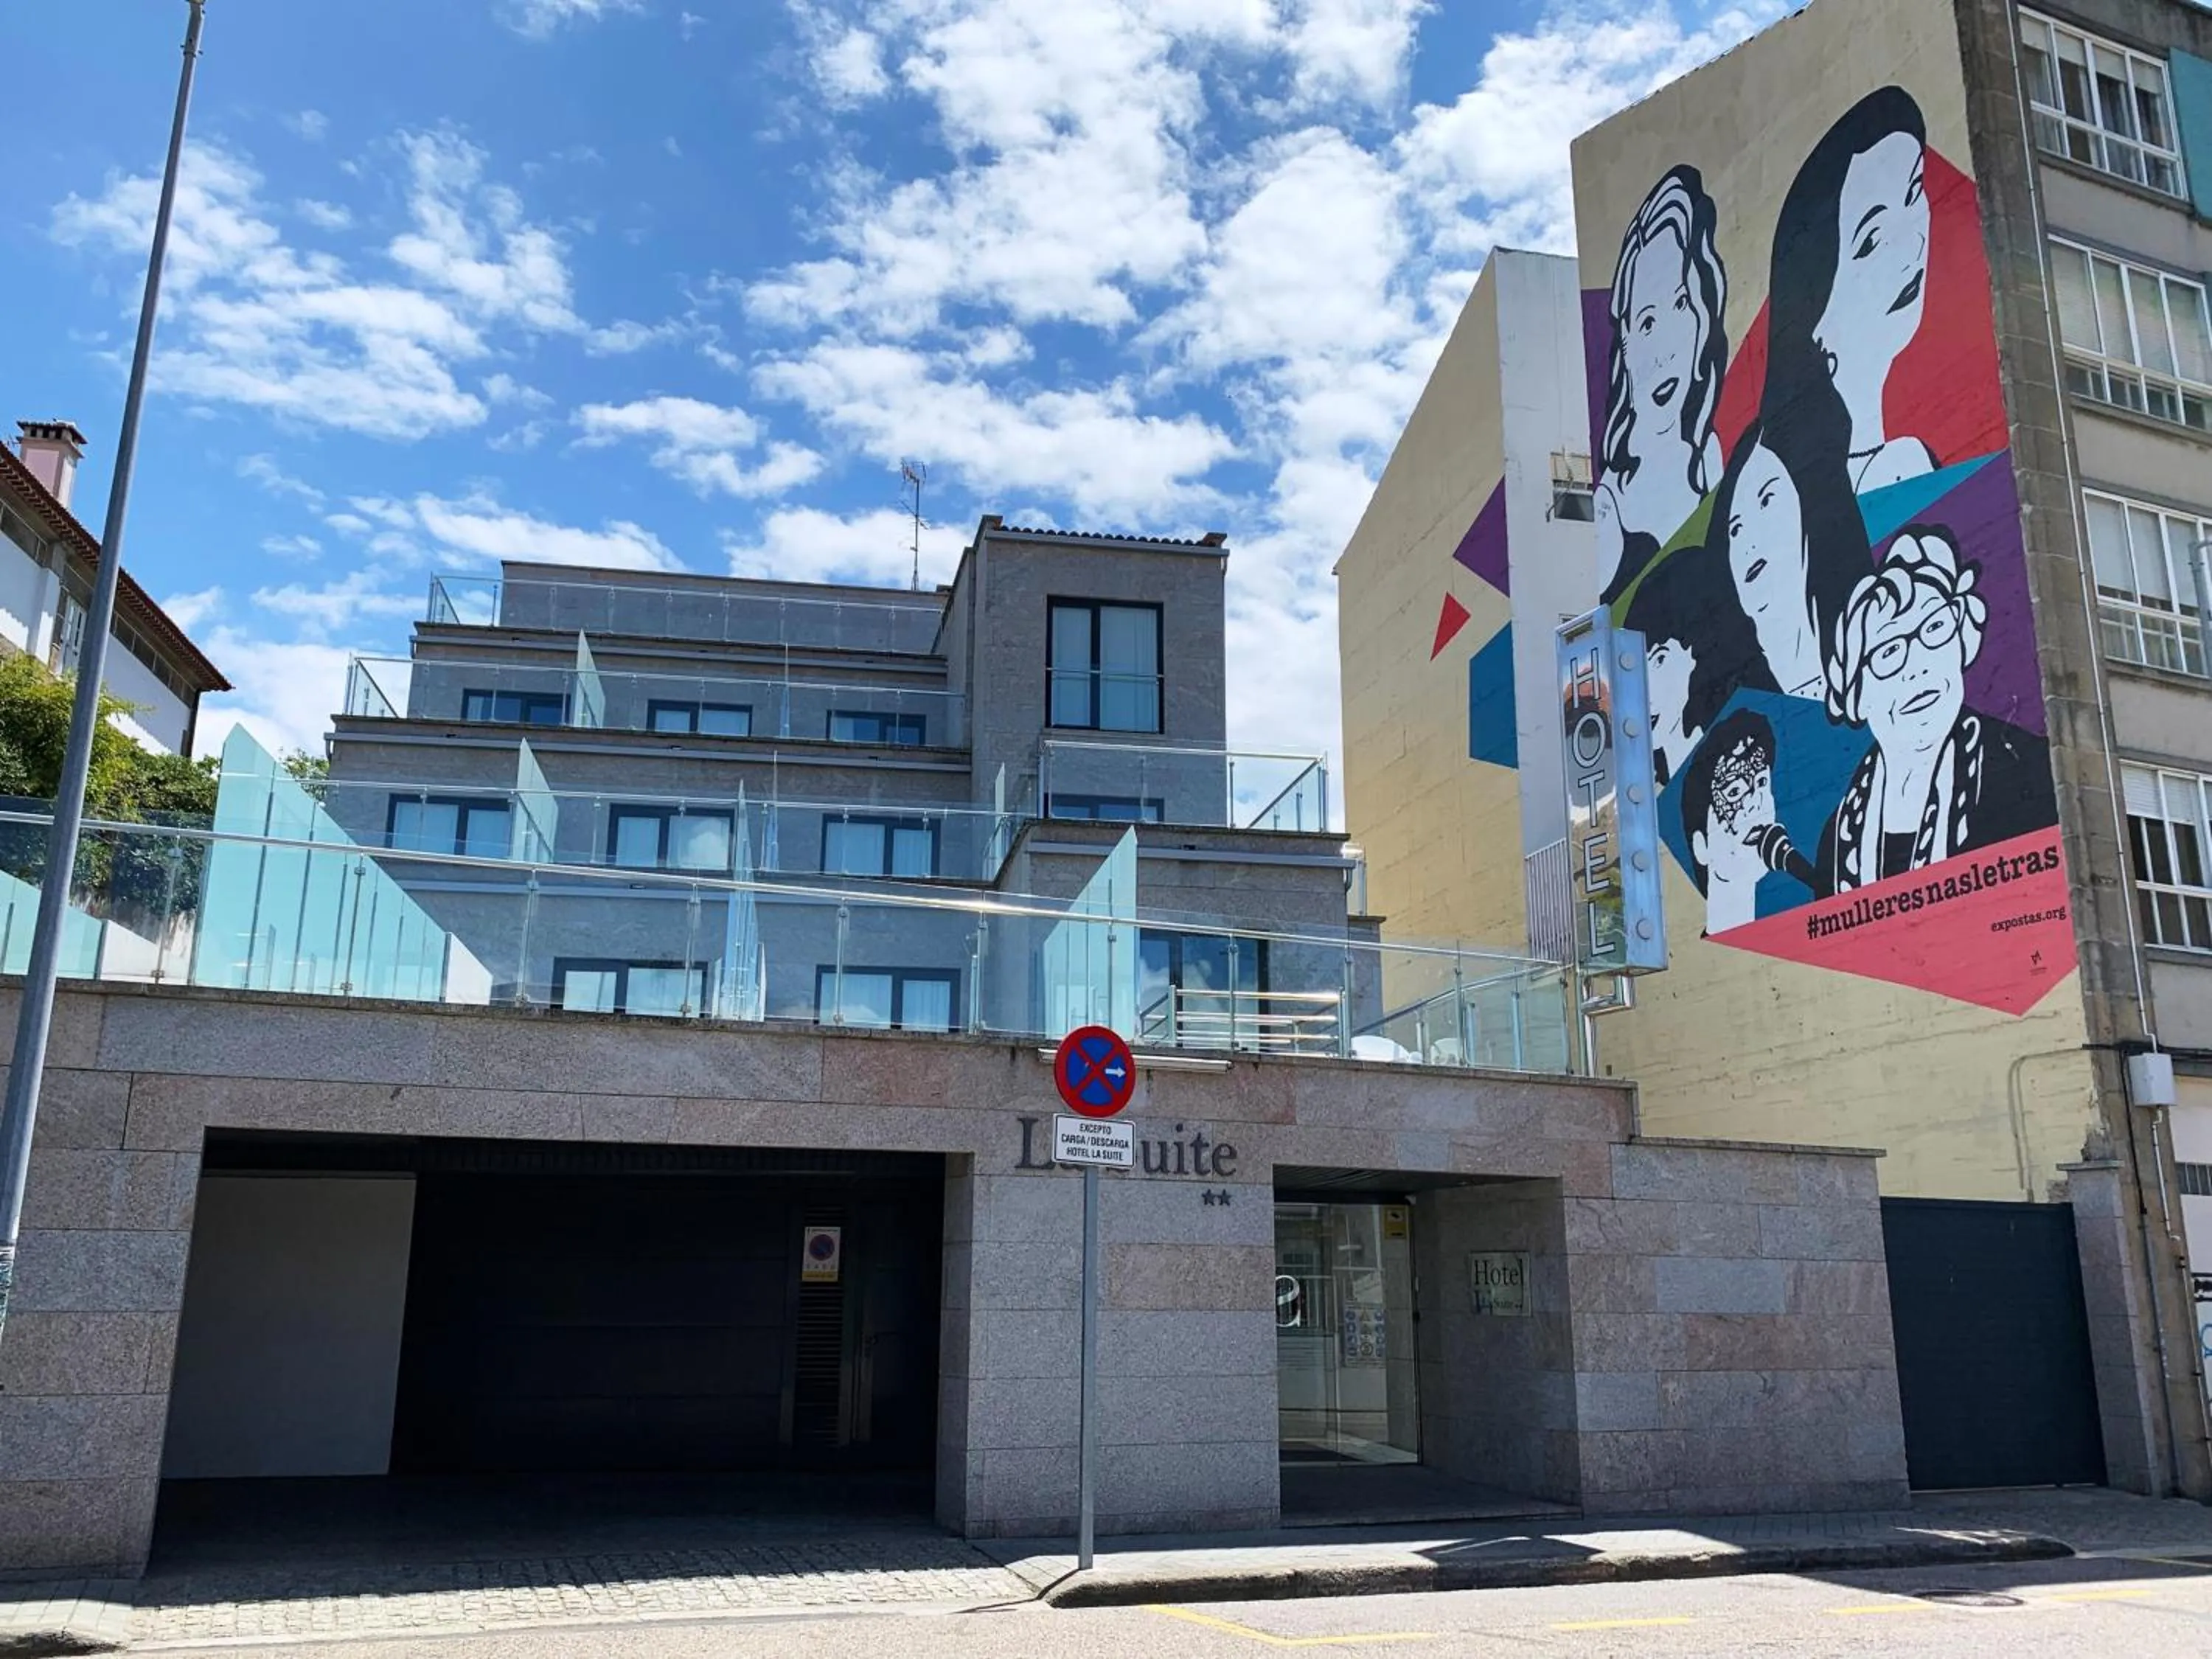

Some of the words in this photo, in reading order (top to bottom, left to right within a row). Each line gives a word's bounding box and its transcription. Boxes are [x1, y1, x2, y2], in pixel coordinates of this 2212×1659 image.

[1570, 647, 1615, 957] HOTEL
[1807, 845, 2060, 939] #mulleresnasletras
[1991, 905, 2067, 932] expostas.org
[1079, 1123, 1113, 1135] EXCEPTO
[1066, 1147, 1091, 1158] HOTEL
[1092, 1149, 1102, 1159] LA
[1102, 1150, 1124, 1161] SUITE
[1108, 1123, 1238, 1177] uite
[1474, 1259, 1524, 1286] Hotel
